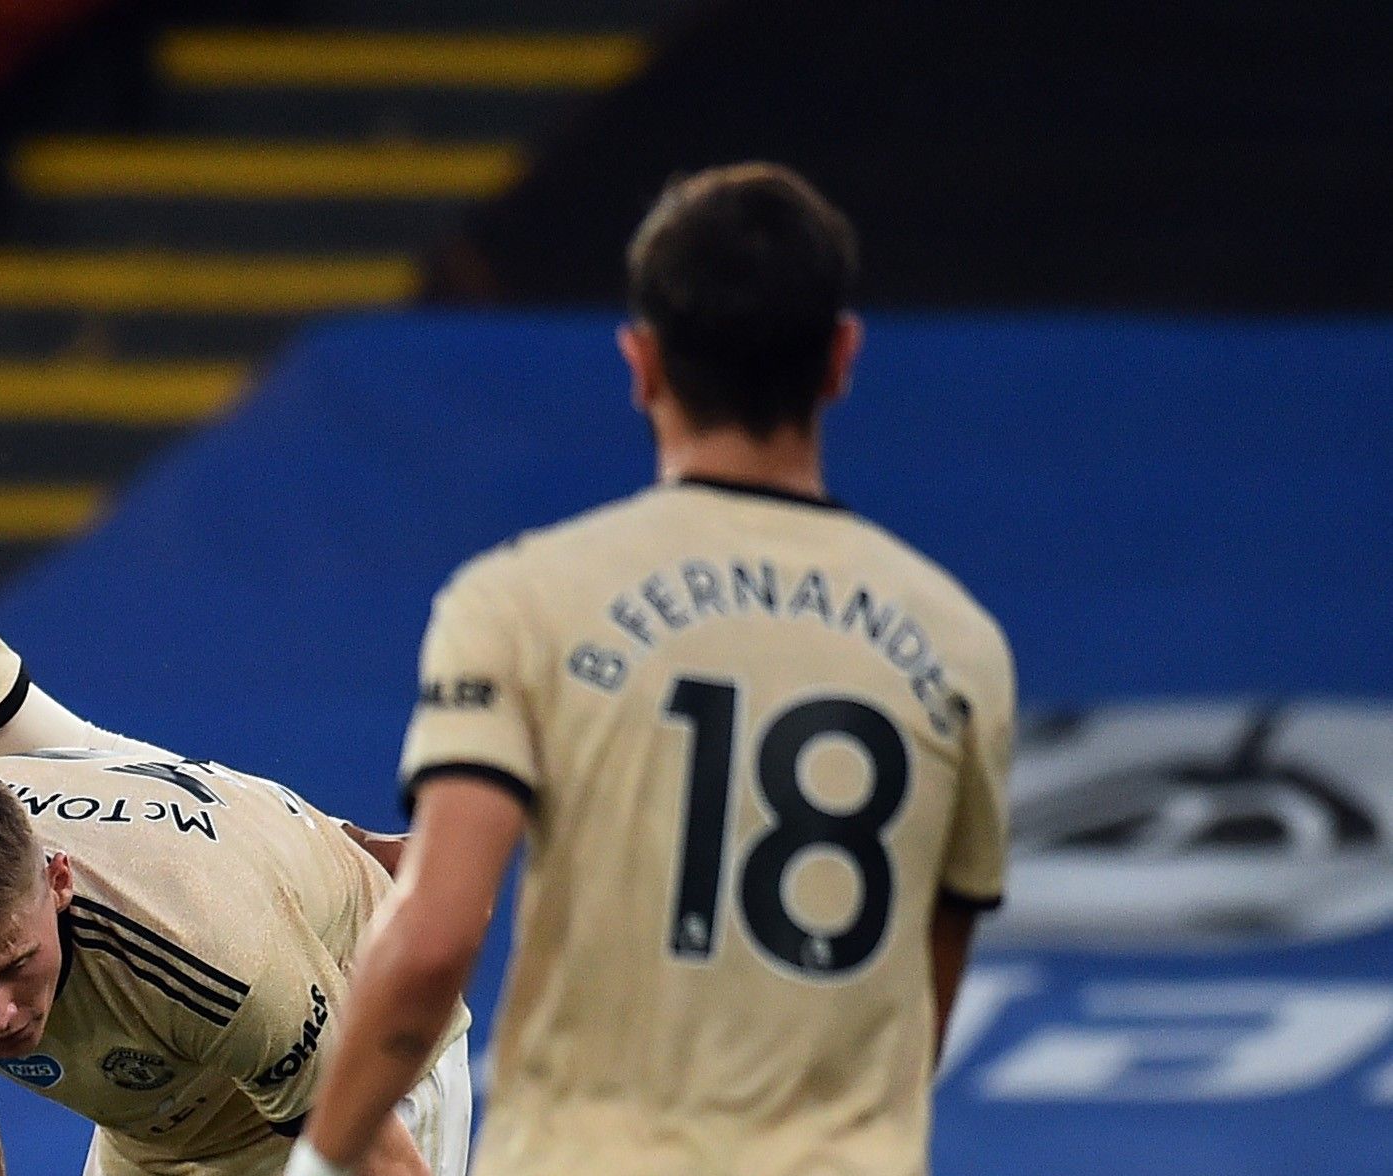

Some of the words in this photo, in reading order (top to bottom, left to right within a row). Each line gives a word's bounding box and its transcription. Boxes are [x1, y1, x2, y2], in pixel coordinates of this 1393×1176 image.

[566, 641, 629, 694] B
[608, 557, 974, 738] FERNANDES
[665, 671, 912, 980] 18
[12, 1063, 51, 1077] NHS
